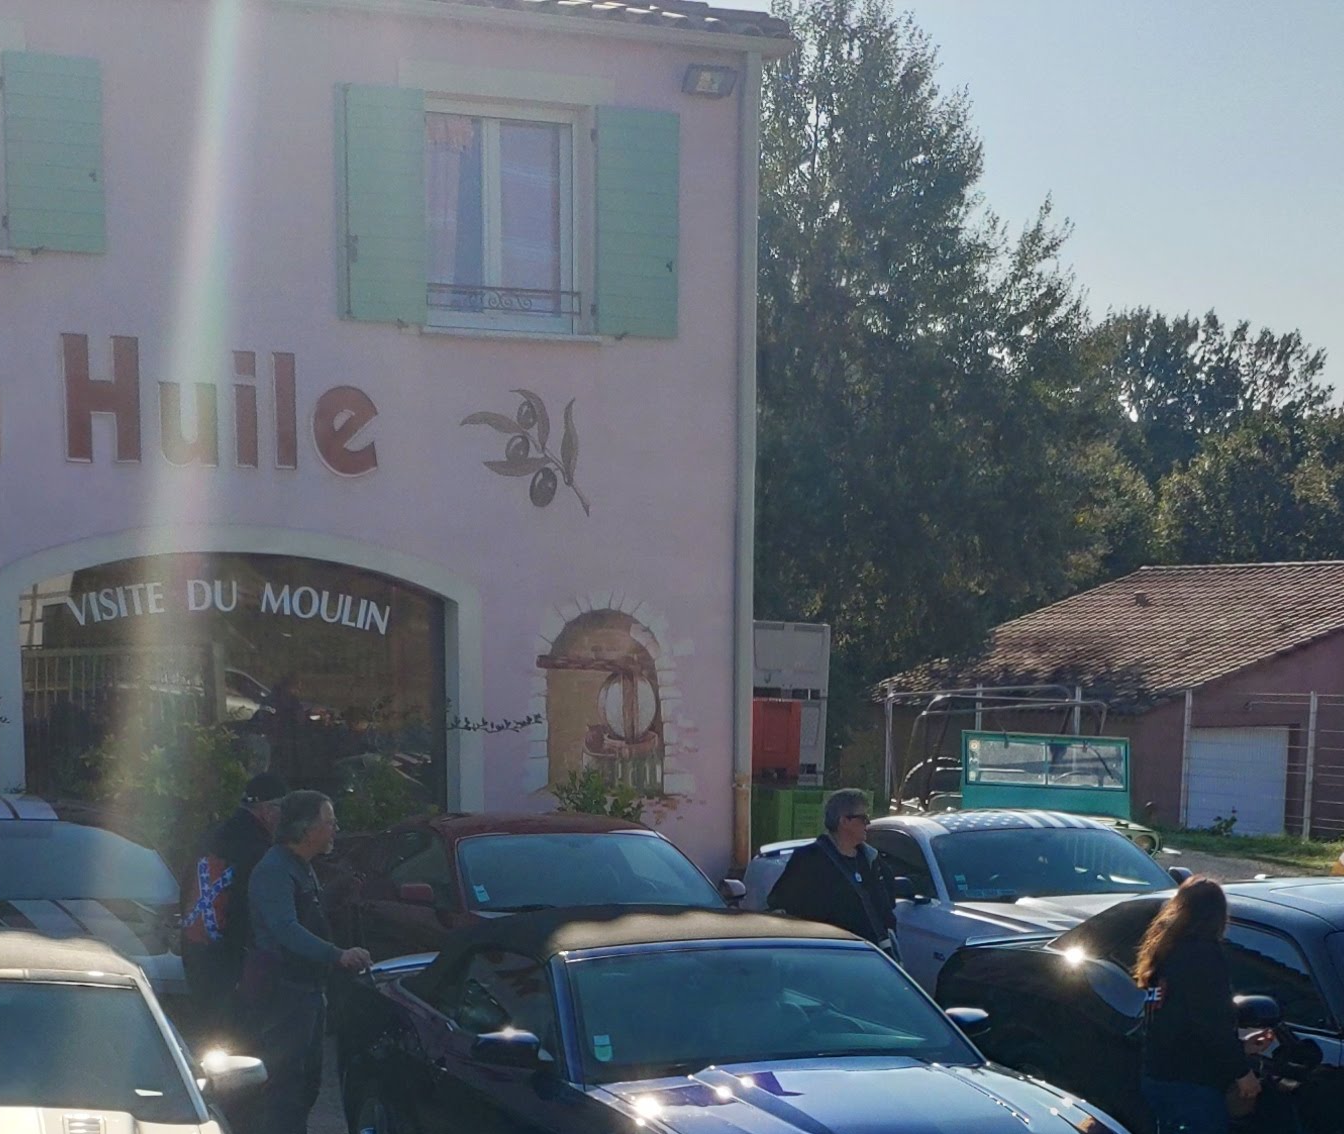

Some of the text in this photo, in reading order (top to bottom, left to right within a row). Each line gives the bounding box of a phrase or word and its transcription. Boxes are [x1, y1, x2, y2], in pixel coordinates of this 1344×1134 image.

[61, 332, 379, 478] Huile
[67, 578, 391, 636] VISITE DU MOULIN
